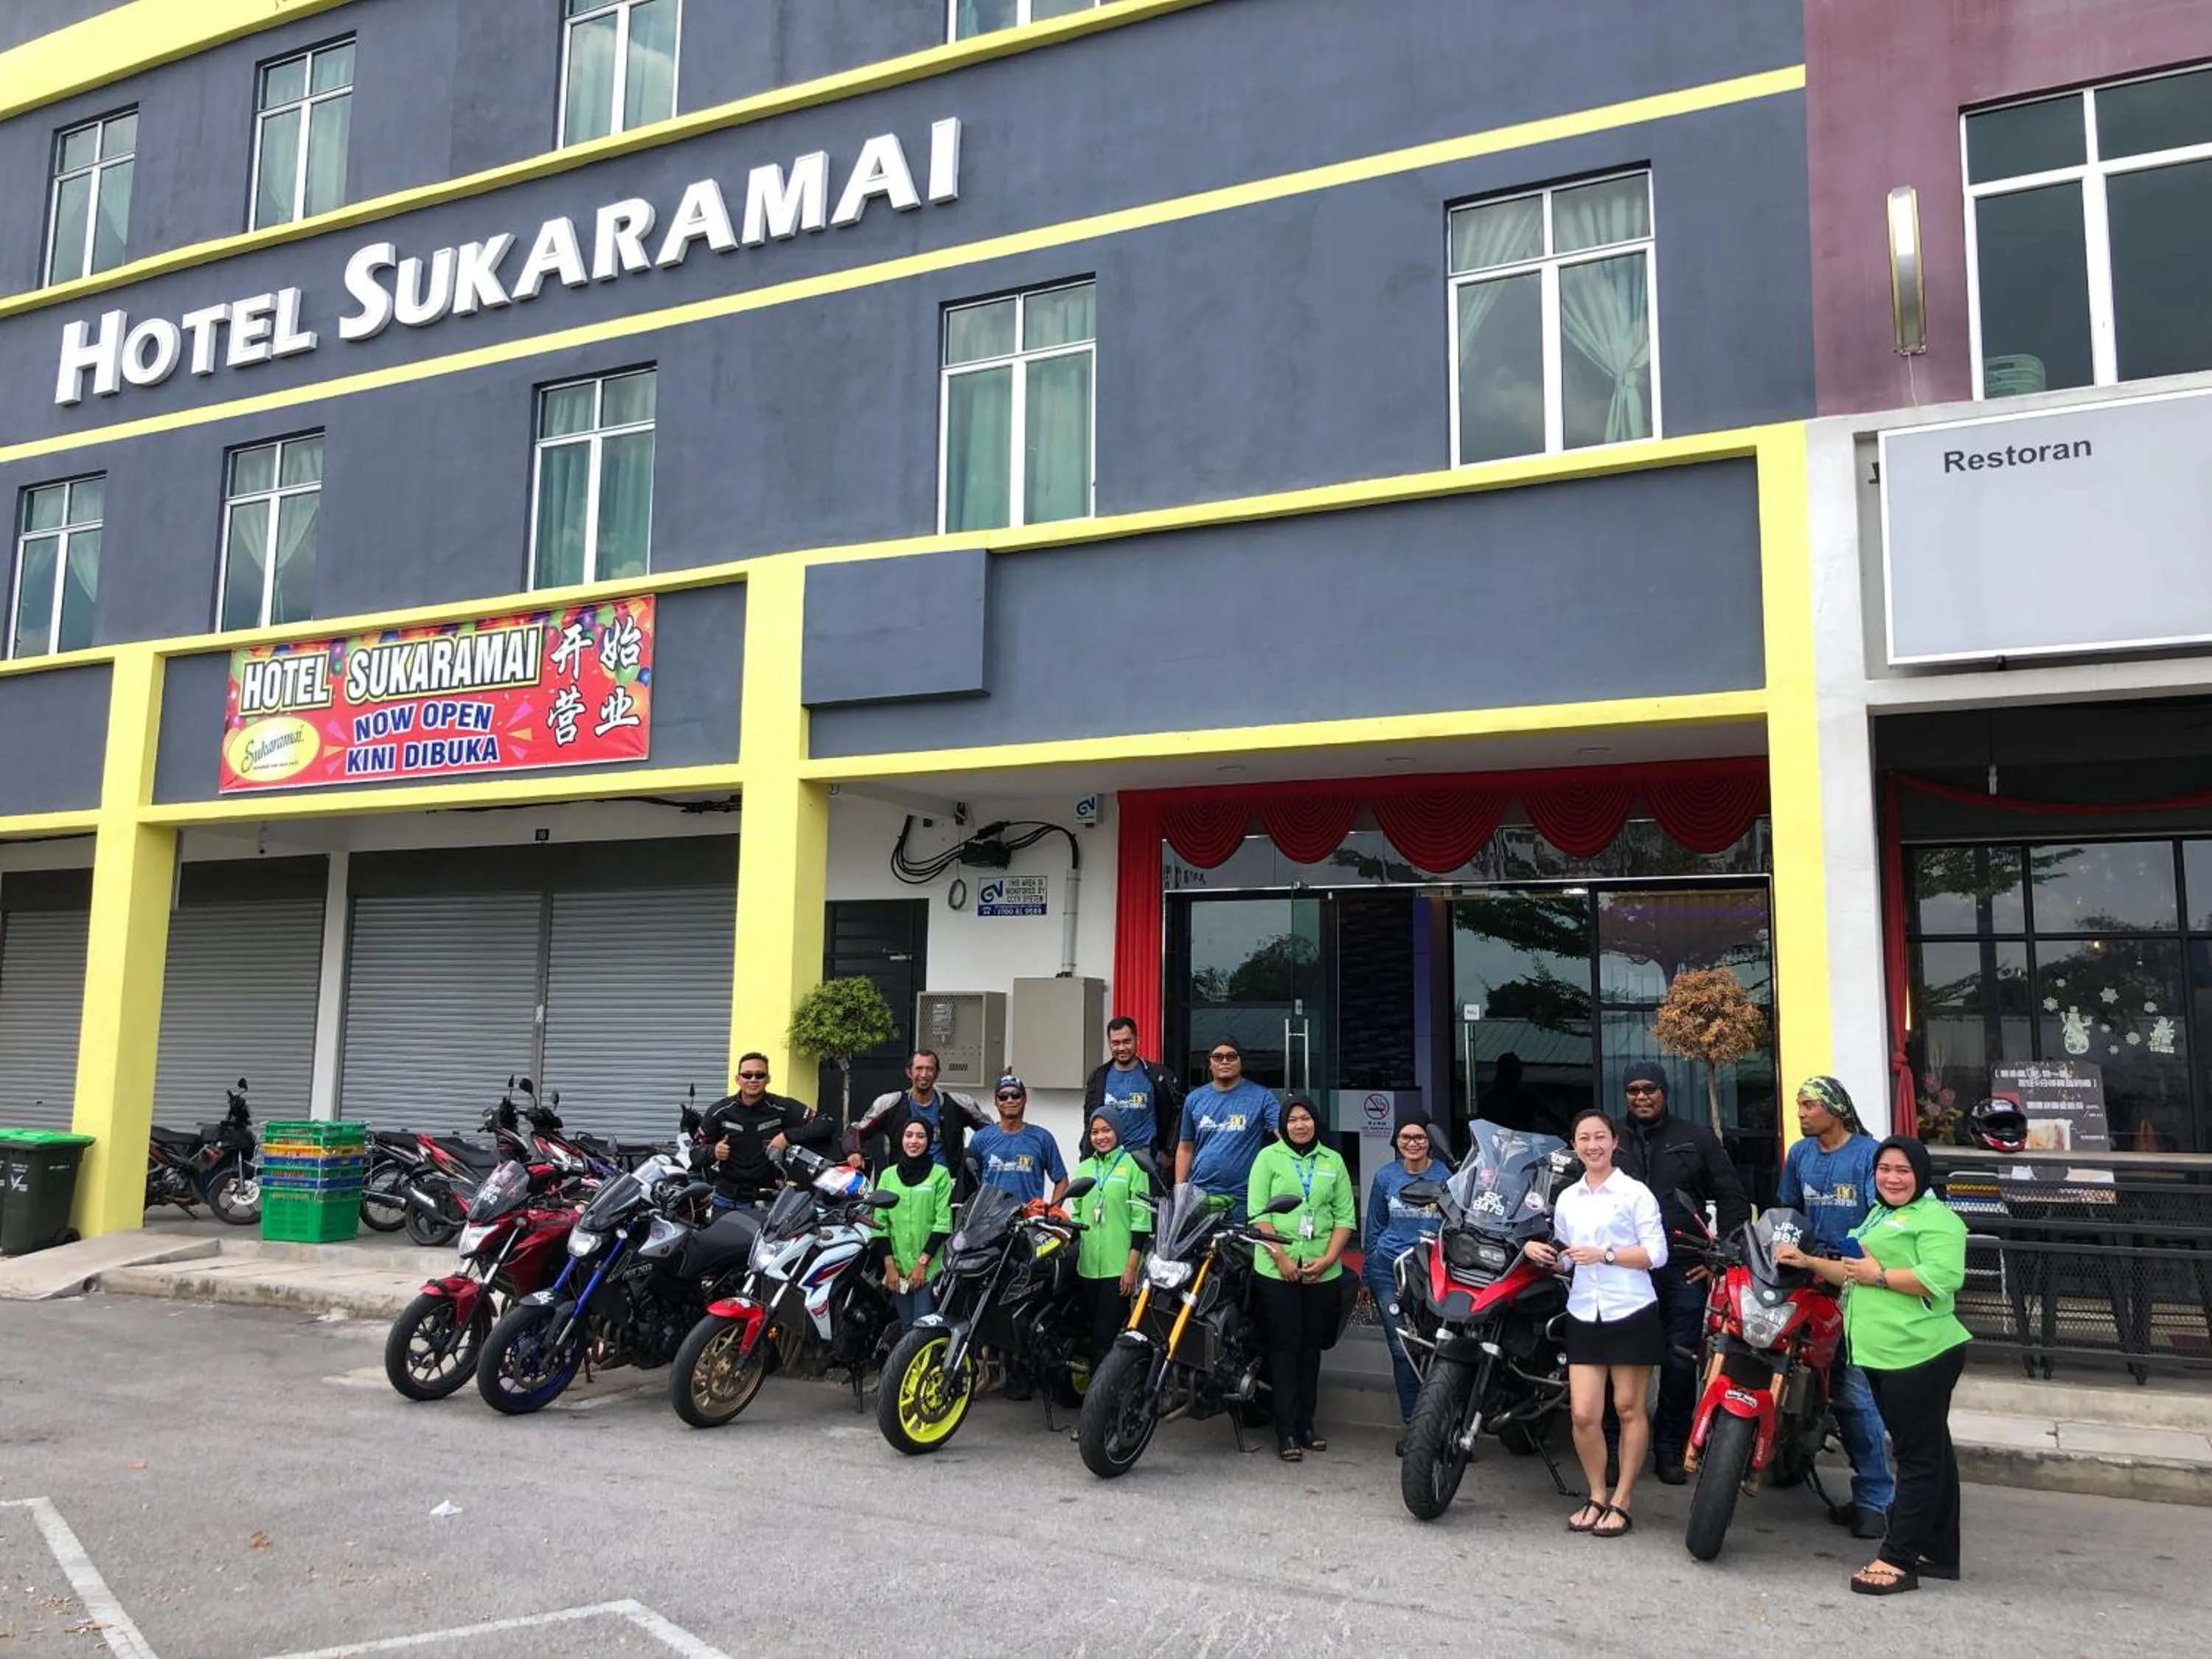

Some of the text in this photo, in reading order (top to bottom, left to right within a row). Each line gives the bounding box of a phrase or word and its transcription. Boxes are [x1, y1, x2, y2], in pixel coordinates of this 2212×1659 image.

[54, 116, 961, 406] HOTEL SUKARAMAI
[1944, 439, 2093, 473] Restoran
[241, 630, 538, 712] HOTEL SUKARAMAI
[550, 616, 644, 681] 开始
[355, 702, 493, 742] NOW OPEN
[546, 686, 640, 746] 营业
[347, 736, 498, 773] KINI DIBUKA
